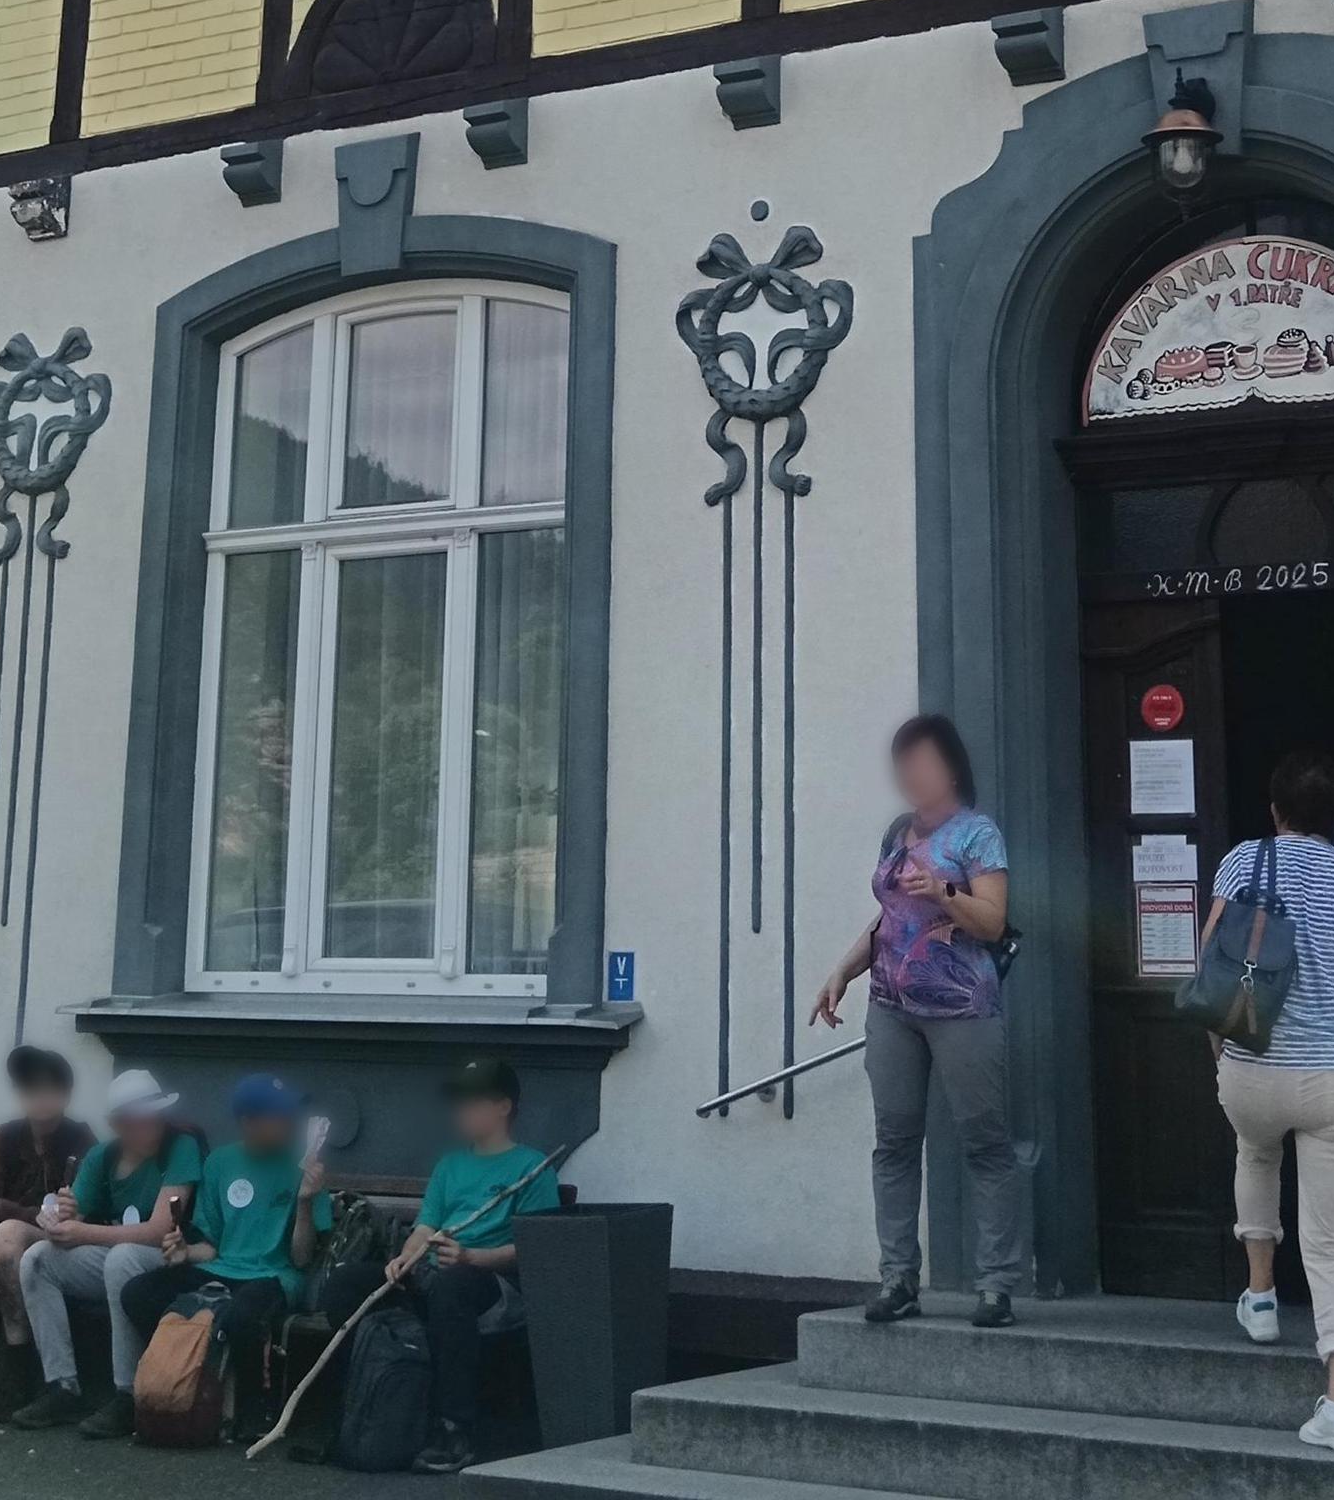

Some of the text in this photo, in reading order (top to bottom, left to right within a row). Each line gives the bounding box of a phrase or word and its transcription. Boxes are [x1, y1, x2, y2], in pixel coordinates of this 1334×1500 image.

[1205, 293, 1221, 312] V
[1096, 250, 1236, 385] KAVÁRNA
[1256, 562, 1329, 591] 2025
[1141, 903, 1193, 912] PROVOZNÍ DOBA
